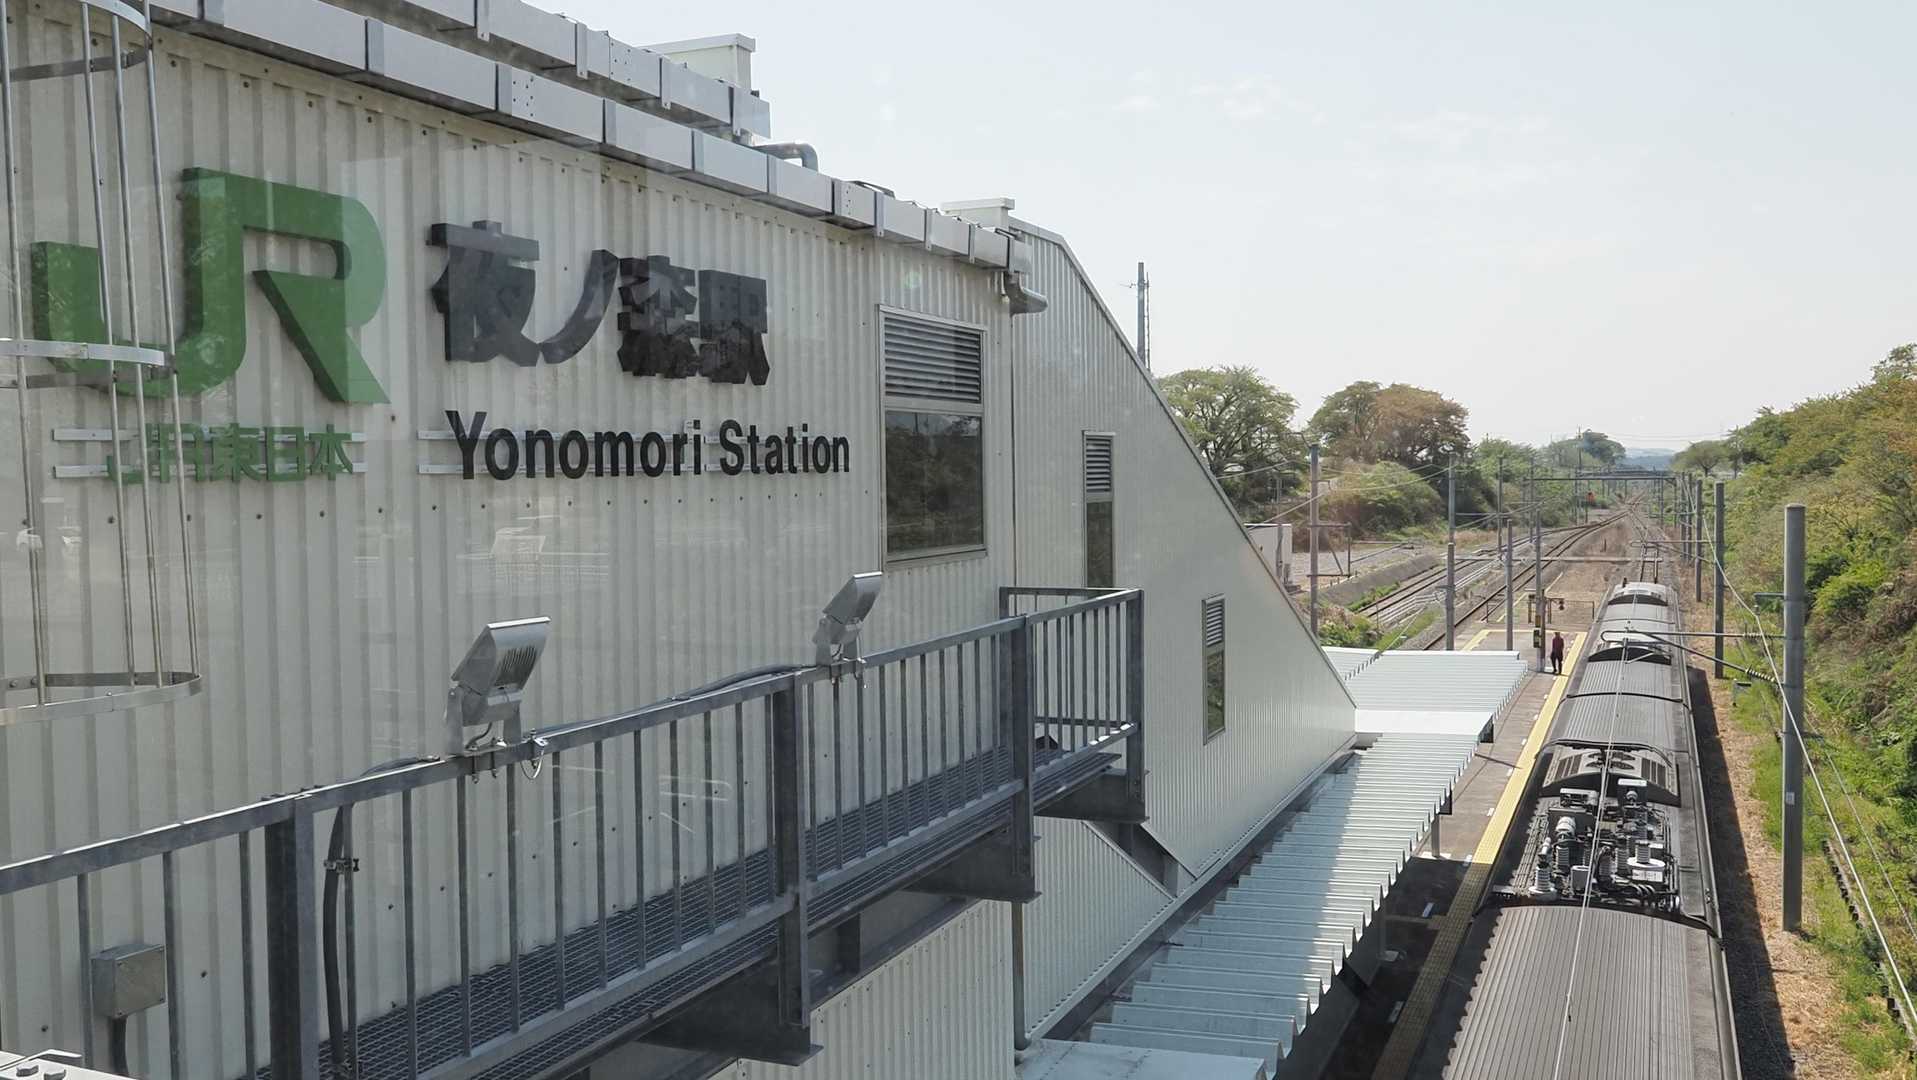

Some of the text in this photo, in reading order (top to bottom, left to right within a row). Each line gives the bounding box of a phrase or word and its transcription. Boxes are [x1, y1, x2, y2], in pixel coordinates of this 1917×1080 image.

[31, 167, 391, 402] JR
[429, 220, 770, 385] 夜ノ森駅
[107, 422, 353, 484] JR東日本
[445, 410, 850, 480] Yonomori Station
